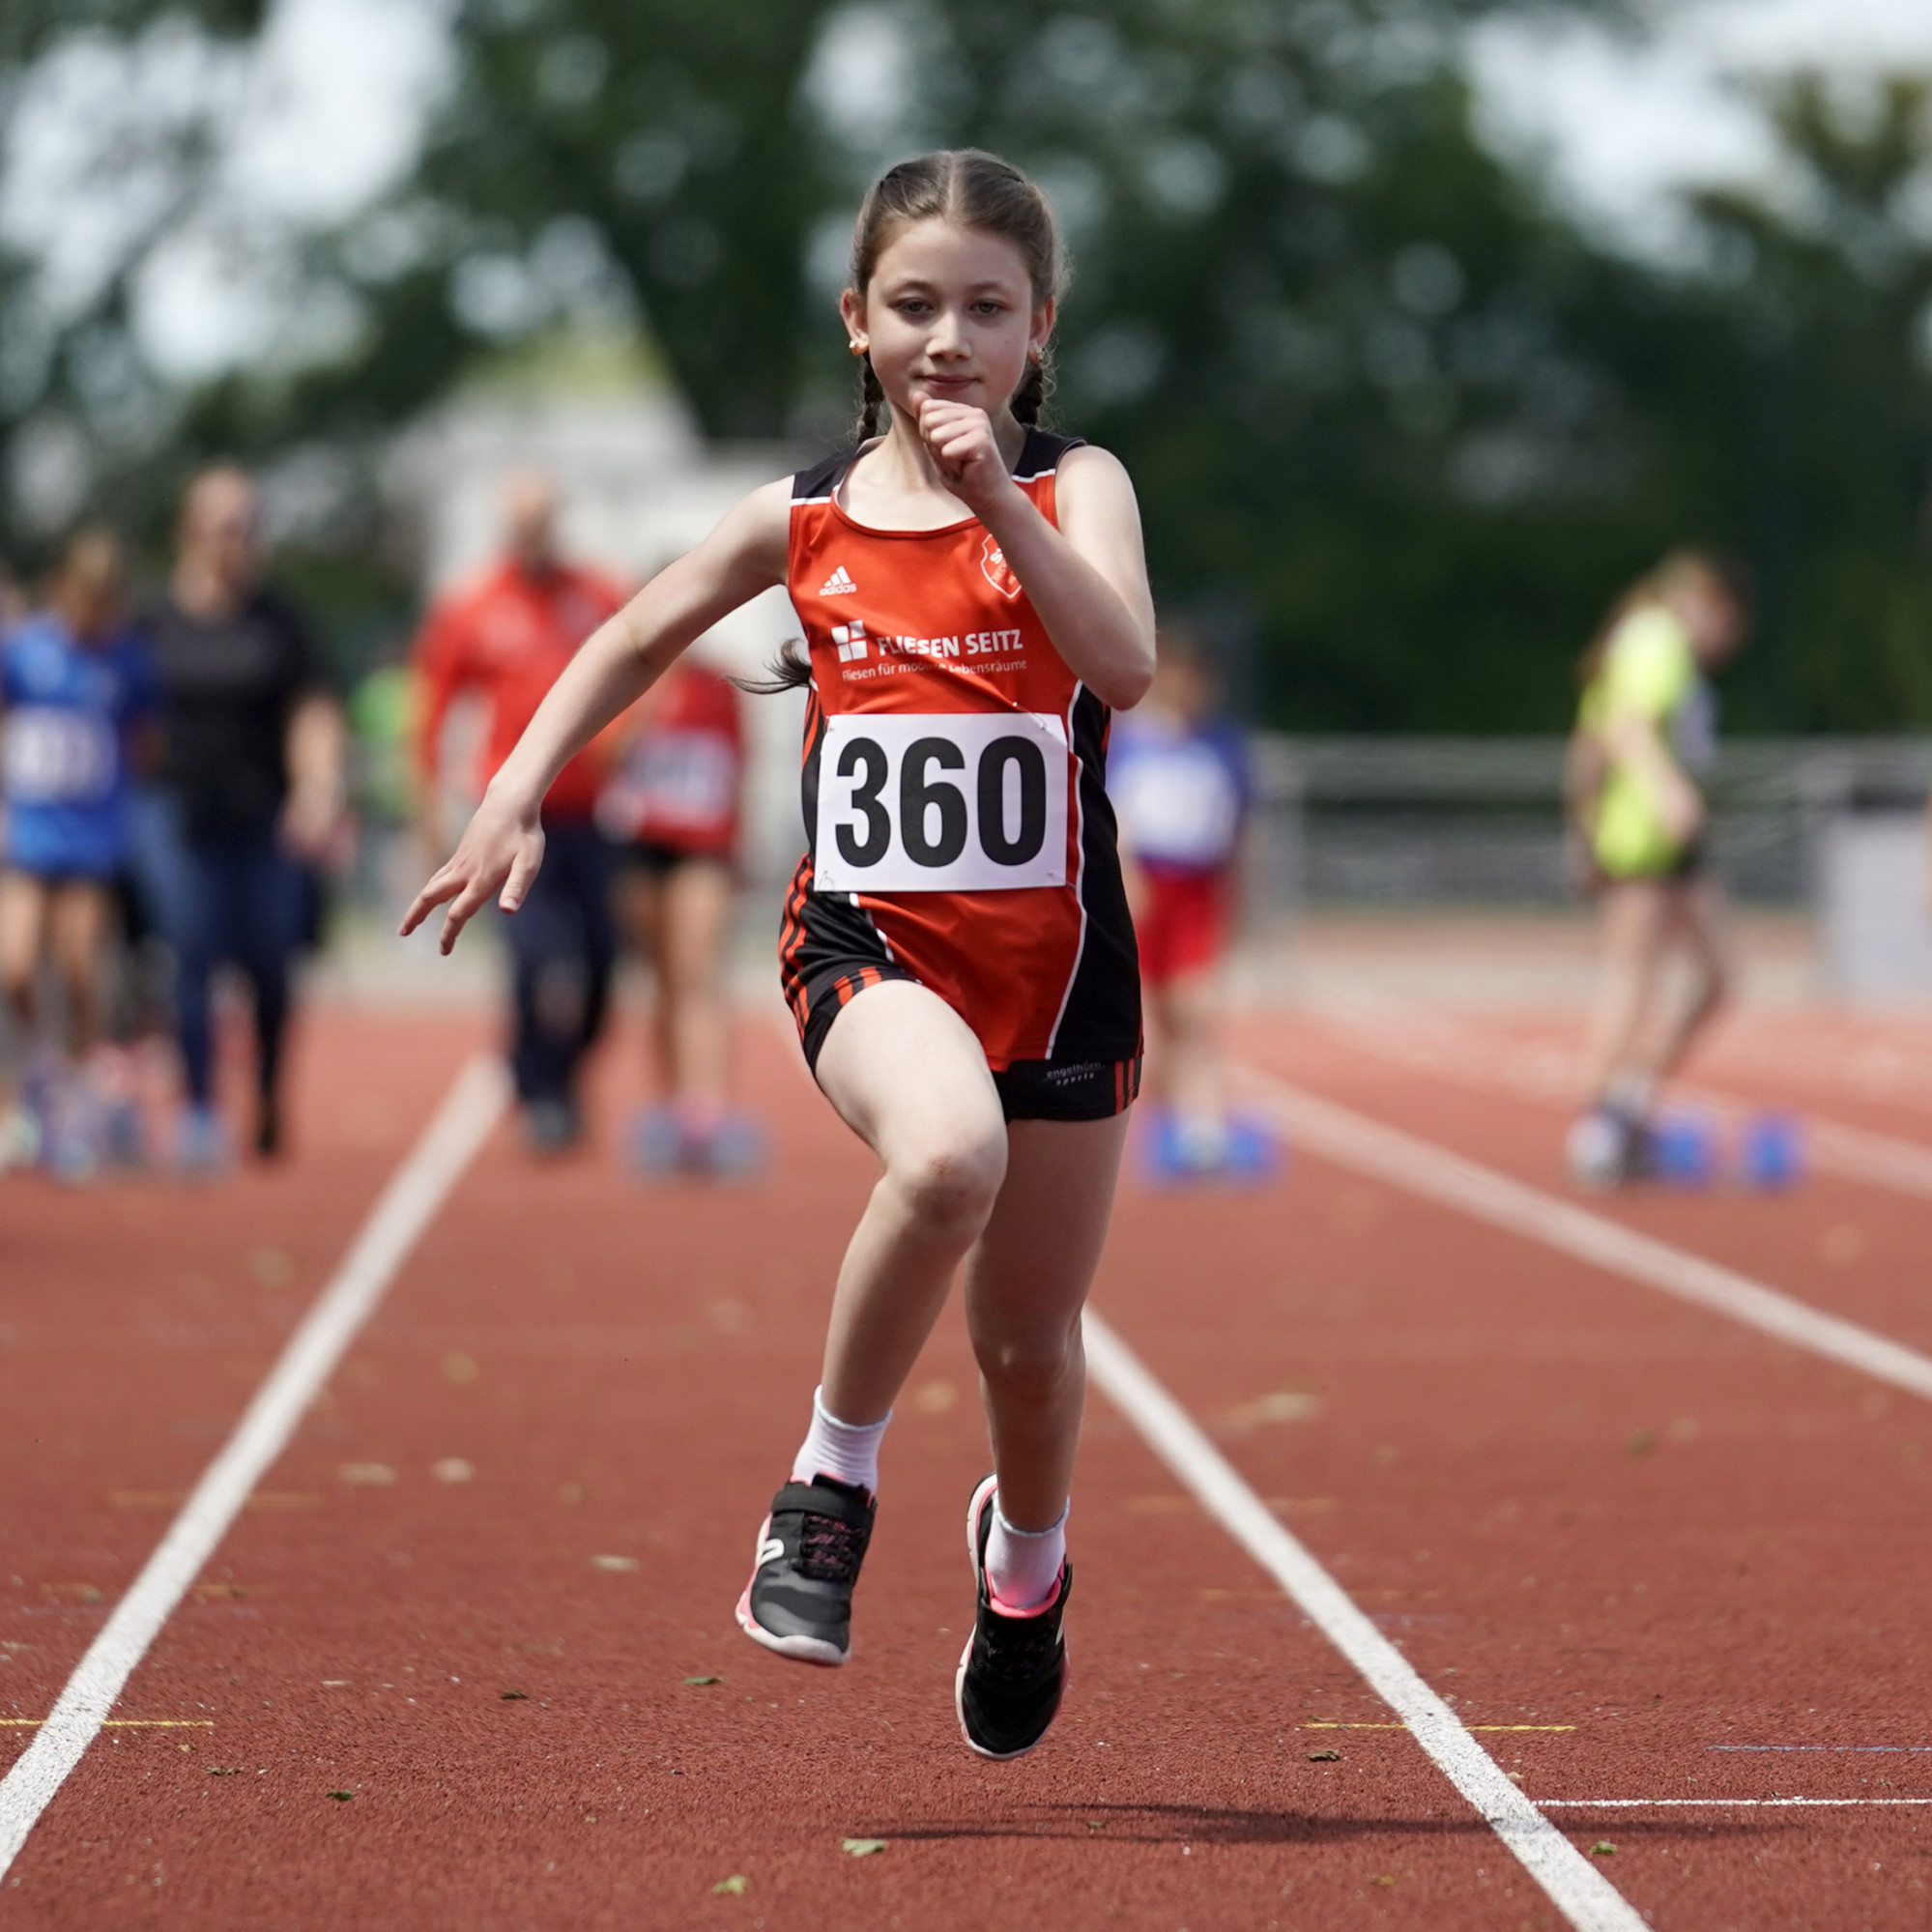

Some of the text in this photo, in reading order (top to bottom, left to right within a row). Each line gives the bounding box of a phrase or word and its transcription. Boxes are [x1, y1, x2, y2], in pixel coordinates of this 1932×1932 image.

[820, 584, 856, 596] adidas
[878, 629, 1024, 658] FLIESEN SEITZ
[878, 663, 896, 676] für
[898, 662, 946, 674] modne
[835, 735, 1047, 868] 360
